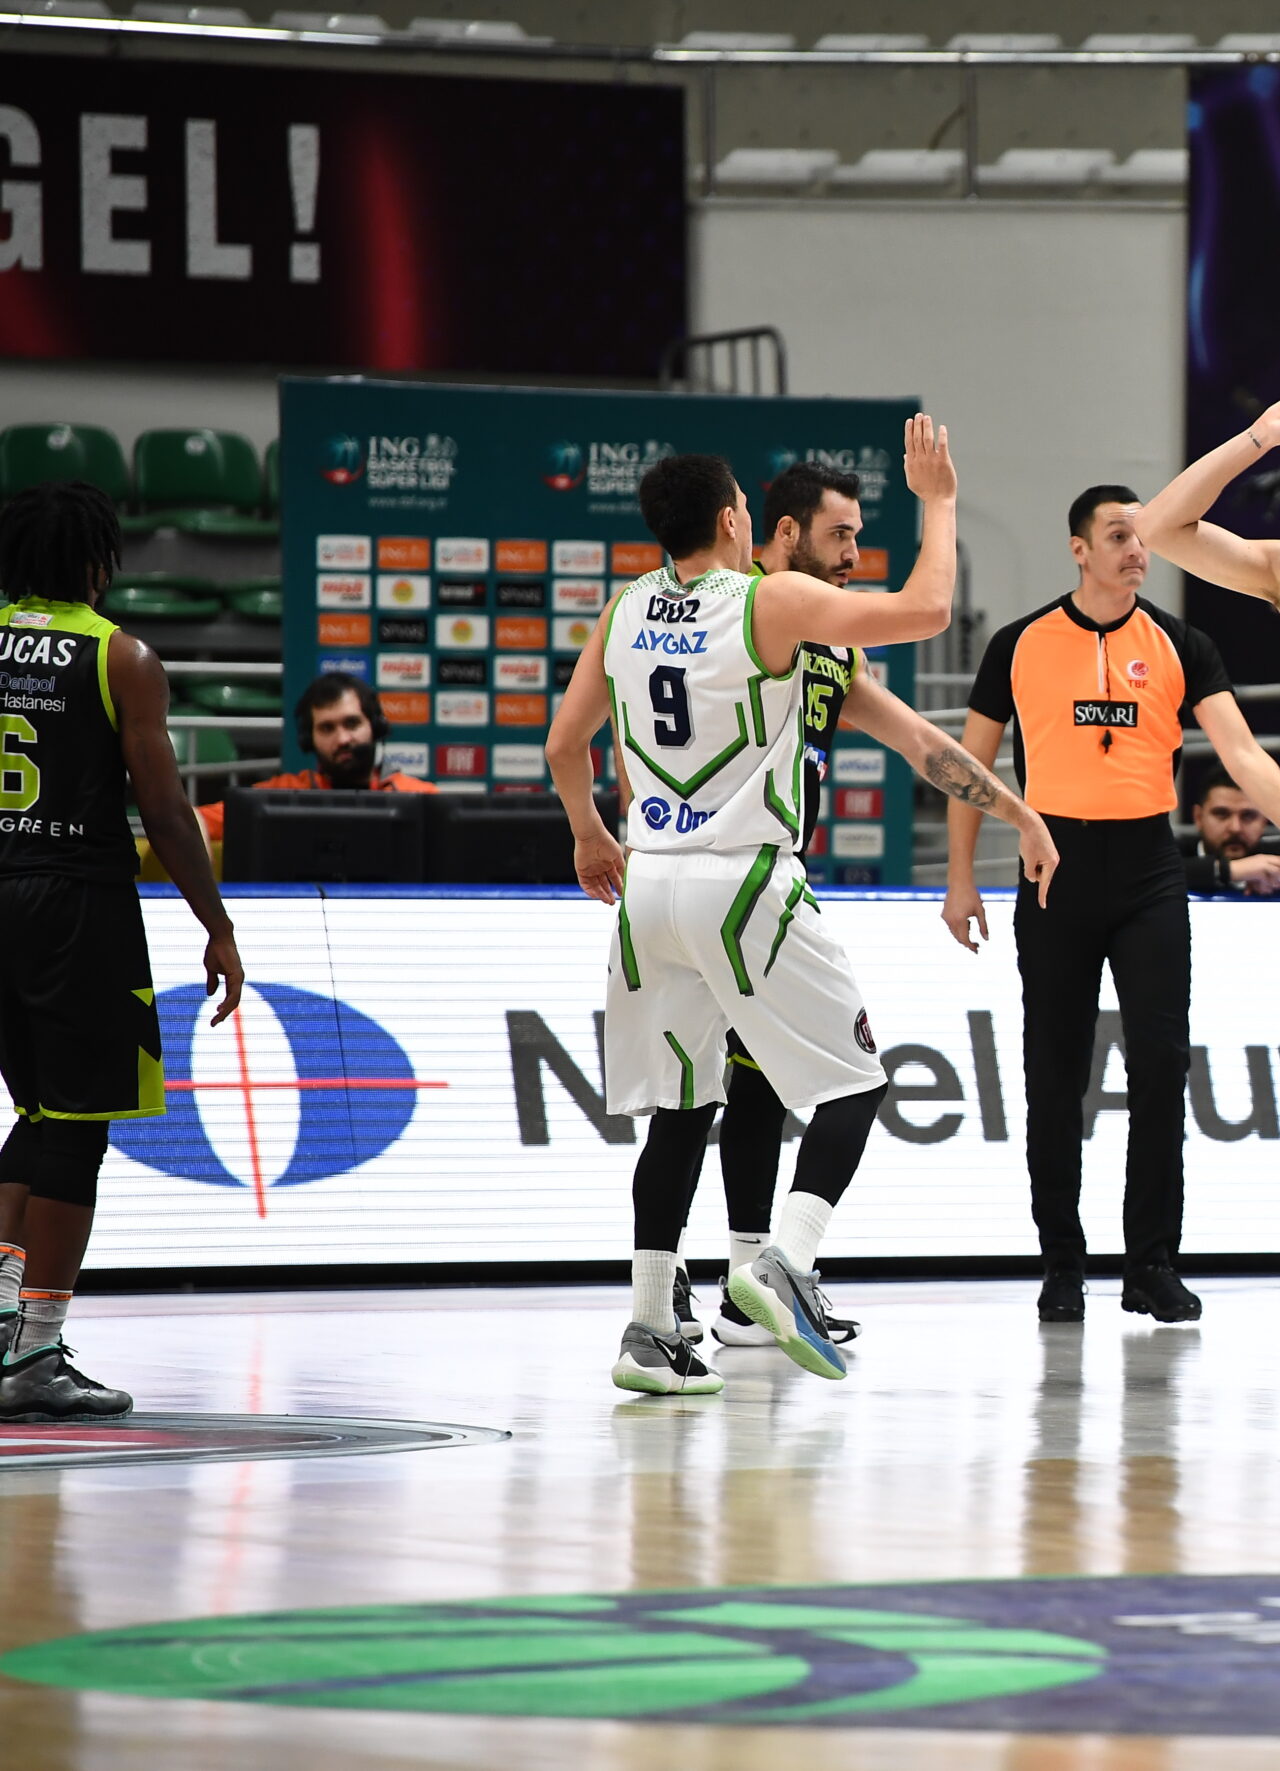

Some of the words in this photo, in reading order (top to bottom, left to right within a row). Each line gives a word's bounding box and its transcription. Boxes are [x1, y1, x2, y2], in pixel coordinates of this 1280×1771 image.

[368, 435, 420, 457] ING
[589, 442, 639, 463] ING
[0, 632, 77, 667] UCAS
[631, 628, 709, 655] AYGAZ
[0, 671, 56, 694] Denipol
[1127, 679, 1149, 689] TBF
[649, 665, 696, 750] 9
[805, 681, 834, 732] 15
[1075, 703, 1136, 726] SÜVARİ
[0, 714, 40, 812] 6
[0, 817, 84, 837] GREEN
[506, 1010, 1009, 1145] Nel
